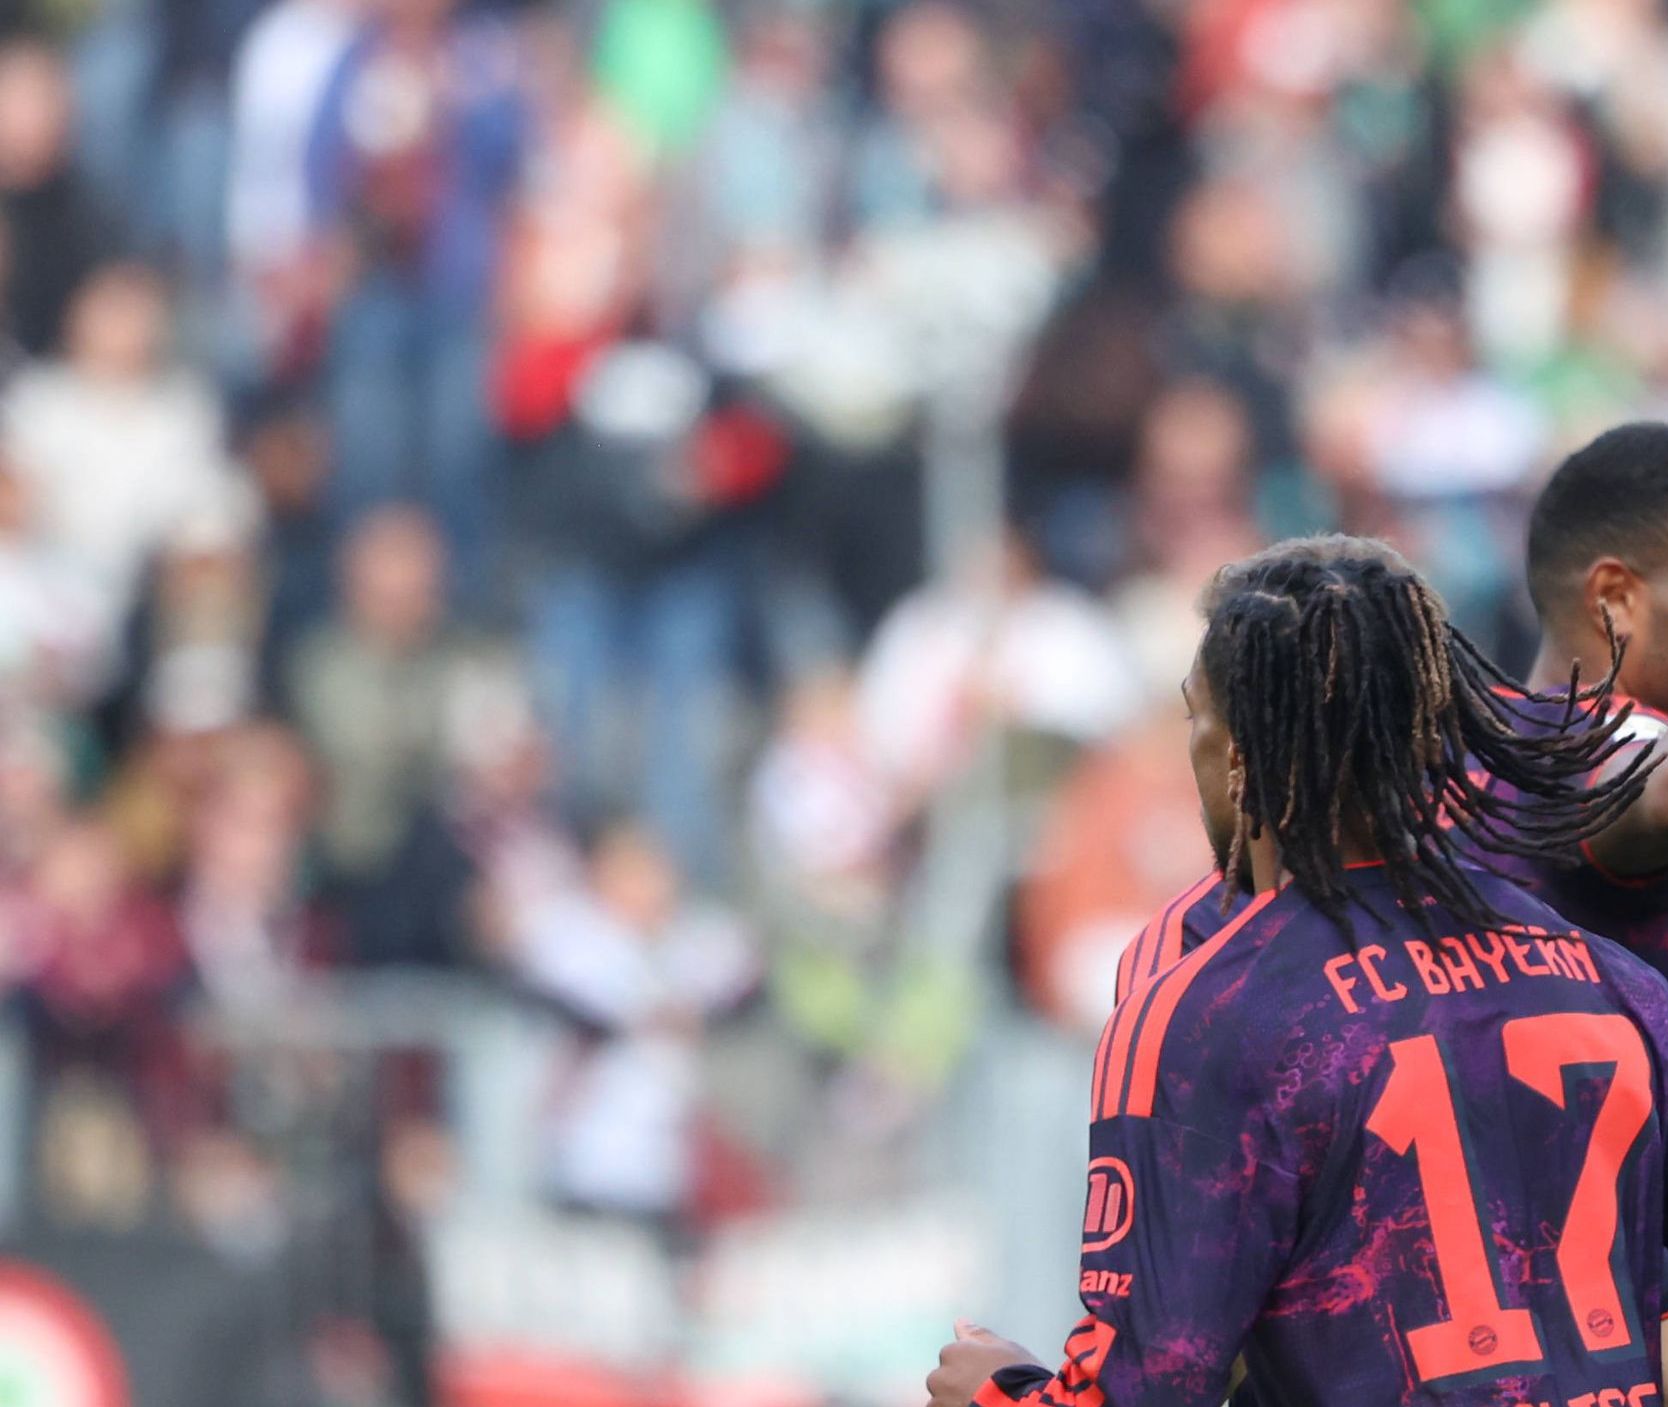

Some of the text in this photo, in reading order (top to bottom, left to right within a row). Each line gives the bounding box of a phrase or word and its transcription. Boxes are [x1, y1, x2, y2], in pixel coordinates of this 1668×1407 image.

[1324, 924, 1600, 1013] FC BAYERN
[1365, 1012, 1654, 1382] 17
